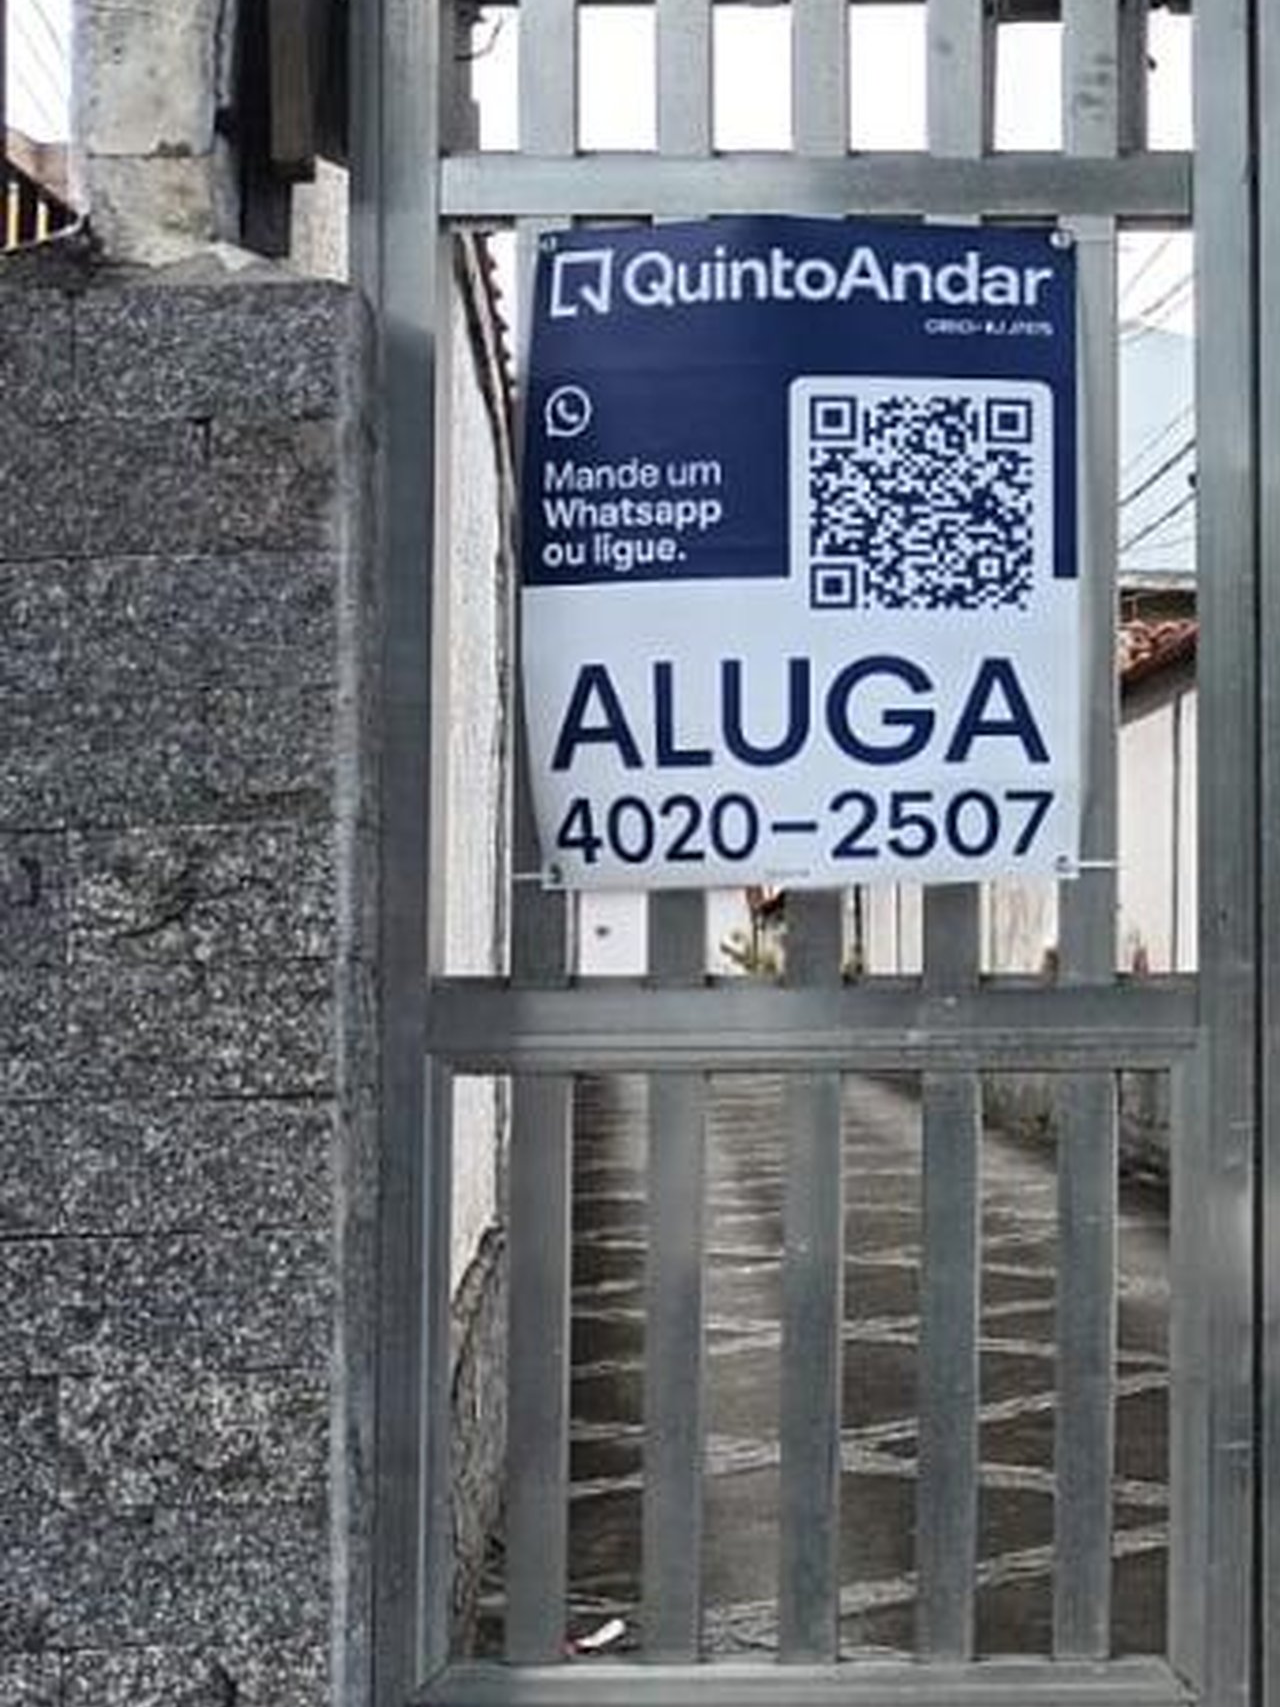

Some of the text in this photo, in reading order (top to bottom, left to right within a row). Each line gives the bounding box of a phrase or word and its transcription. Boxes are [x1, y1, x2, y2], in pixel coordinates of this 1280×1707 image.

[623, 246, 1053, 307] QuintoAndar
[543, 457, 722, 492] Mande um
[542, 496, 722, 531] Whatsapp
[542, 532, 687, 572] ou ligue.
[551, 655, 1051, 772] ALUGA
[556, 790, 1056, 865] 4020-2507
